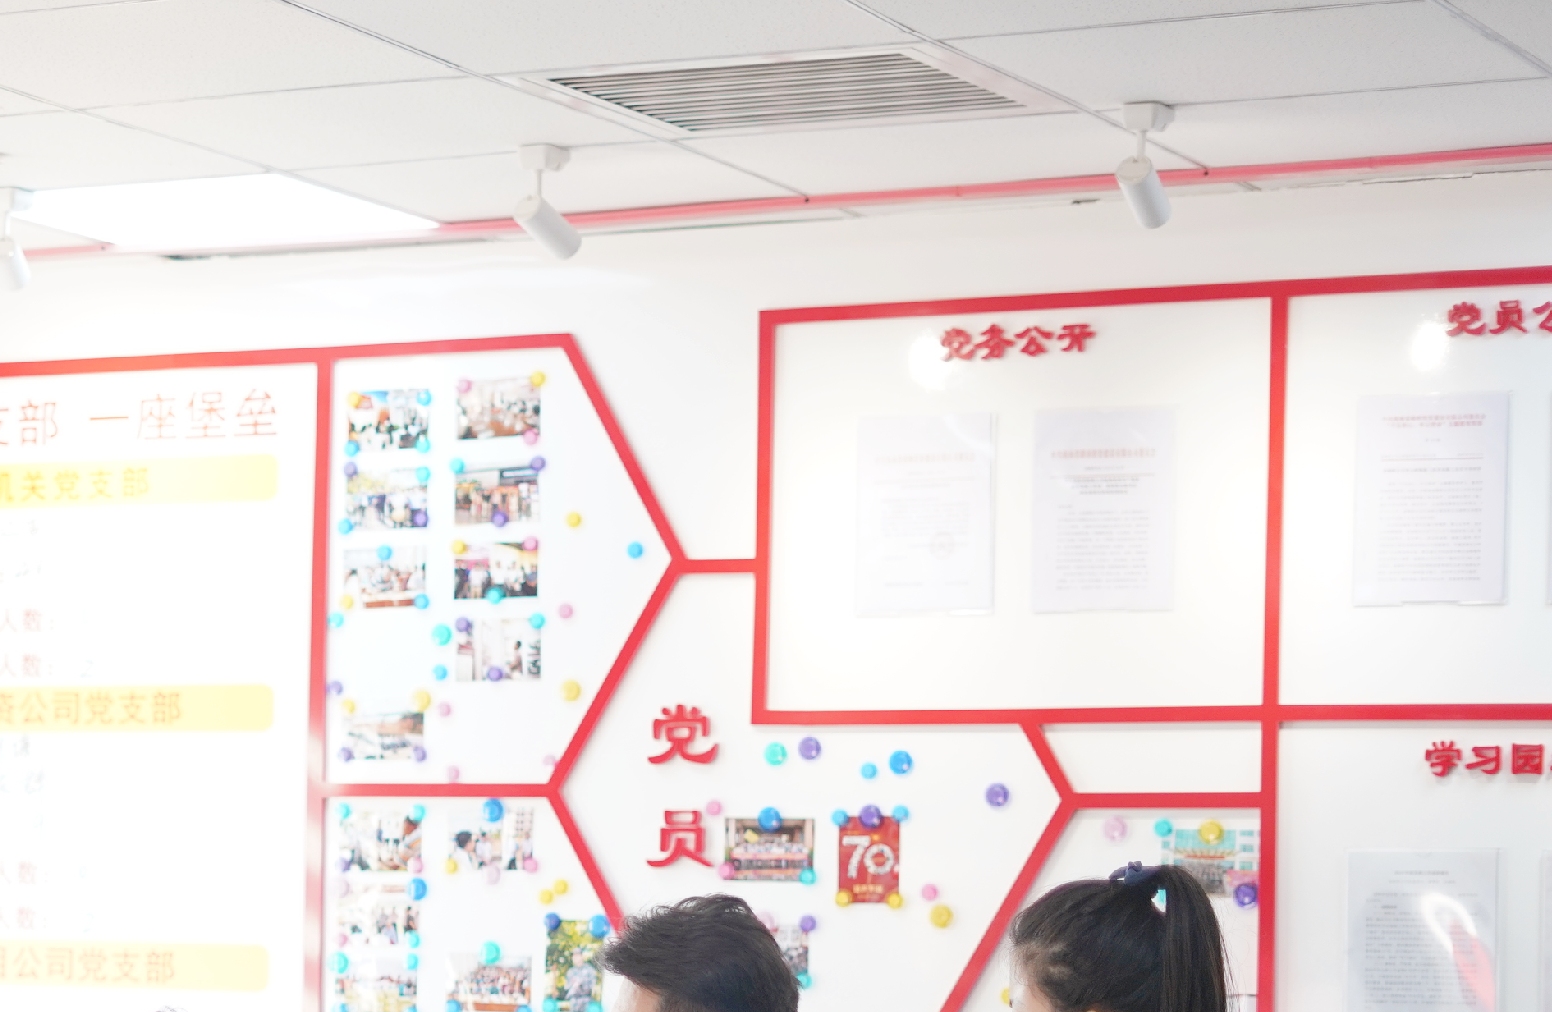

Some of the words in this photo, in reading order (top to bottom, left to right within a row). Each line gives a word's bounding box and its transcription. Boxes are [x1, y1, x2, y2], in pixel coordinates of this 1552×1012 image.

[940, 323, 1097, 362] 党务公开
[89, 388, 279, 441] 一座堡垒
[1425, 740, 1544, 778] 学习园
[646, 704, 720, 868] 党员
[842, 835, 894, 880] 70
